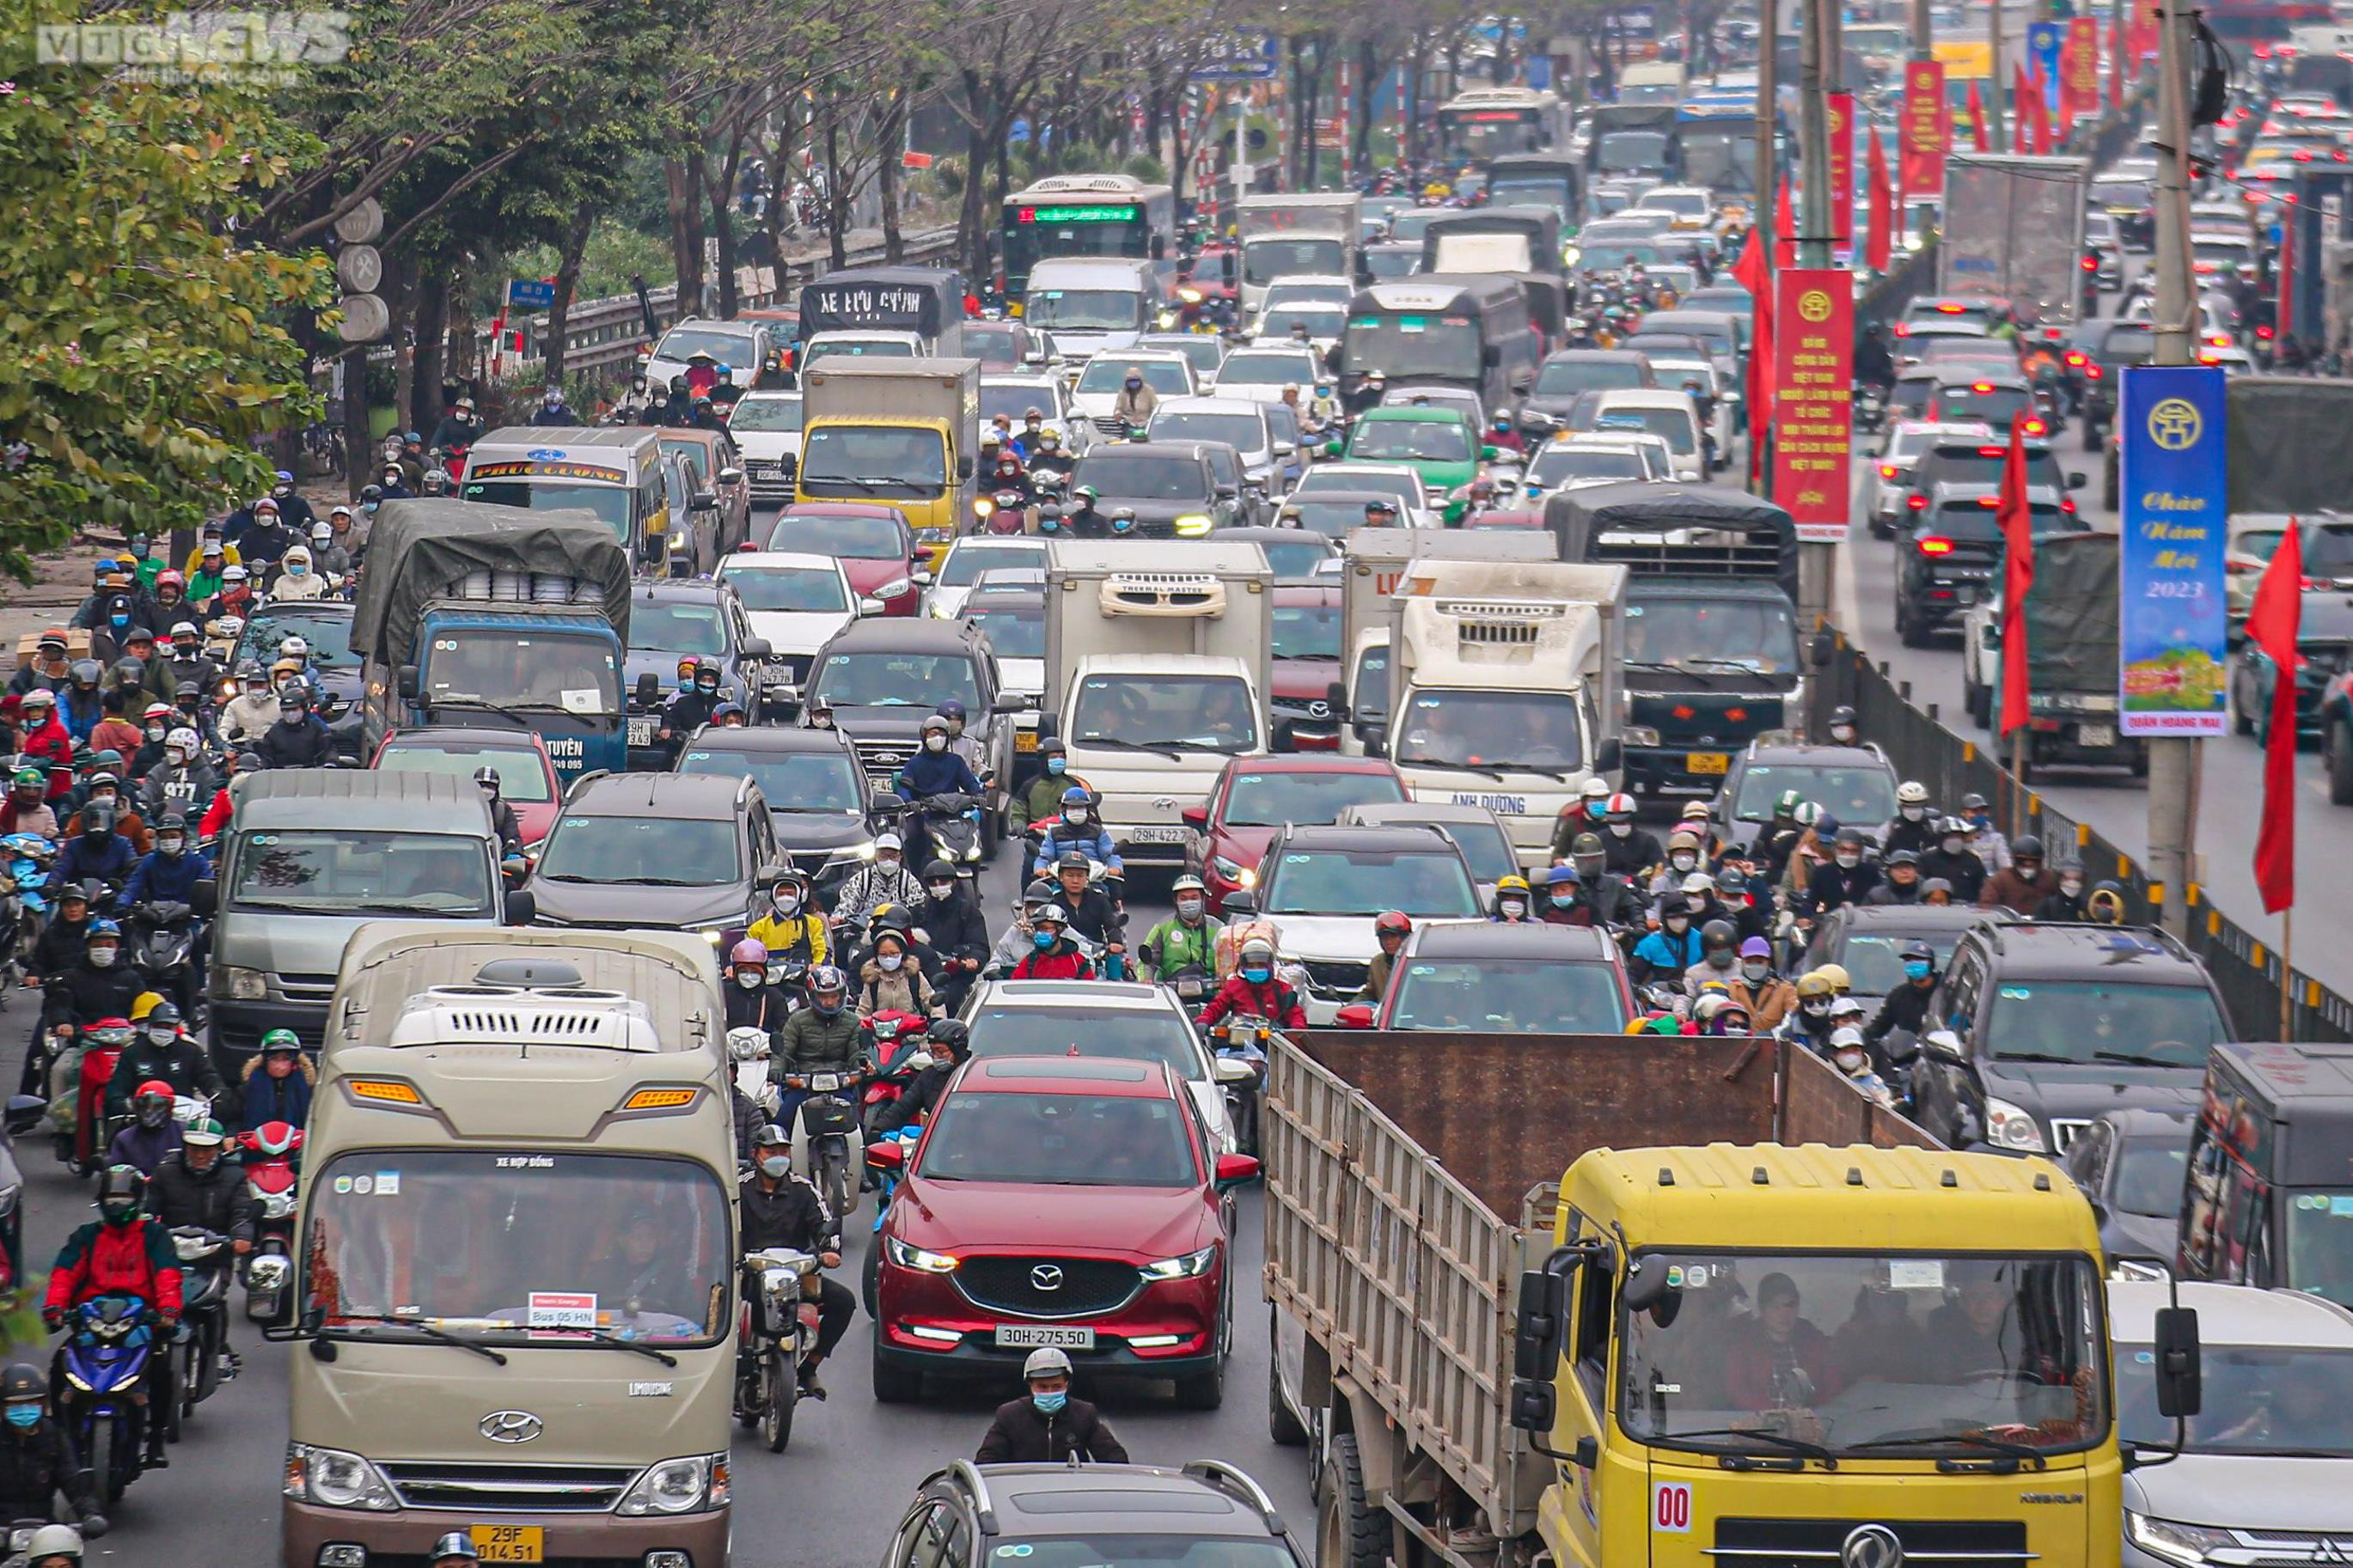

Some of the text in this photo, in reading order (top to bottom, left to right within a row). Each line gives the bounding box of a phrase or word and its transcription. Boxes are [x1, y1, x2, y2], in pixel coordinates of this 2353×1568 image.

[2147, 581, 2204, 597] 2023
[495, 1157, 510, 1167] XE
[533, 1311, 592, 1322] Bus 05 HN
[1004, 1329, 1085, 1345] 30H-275.50
[1658, 1486, 1688, 1527] 00
[491, 1528, 523, 1542] 29F
[477, 1544, 533, 1559] 014.51
